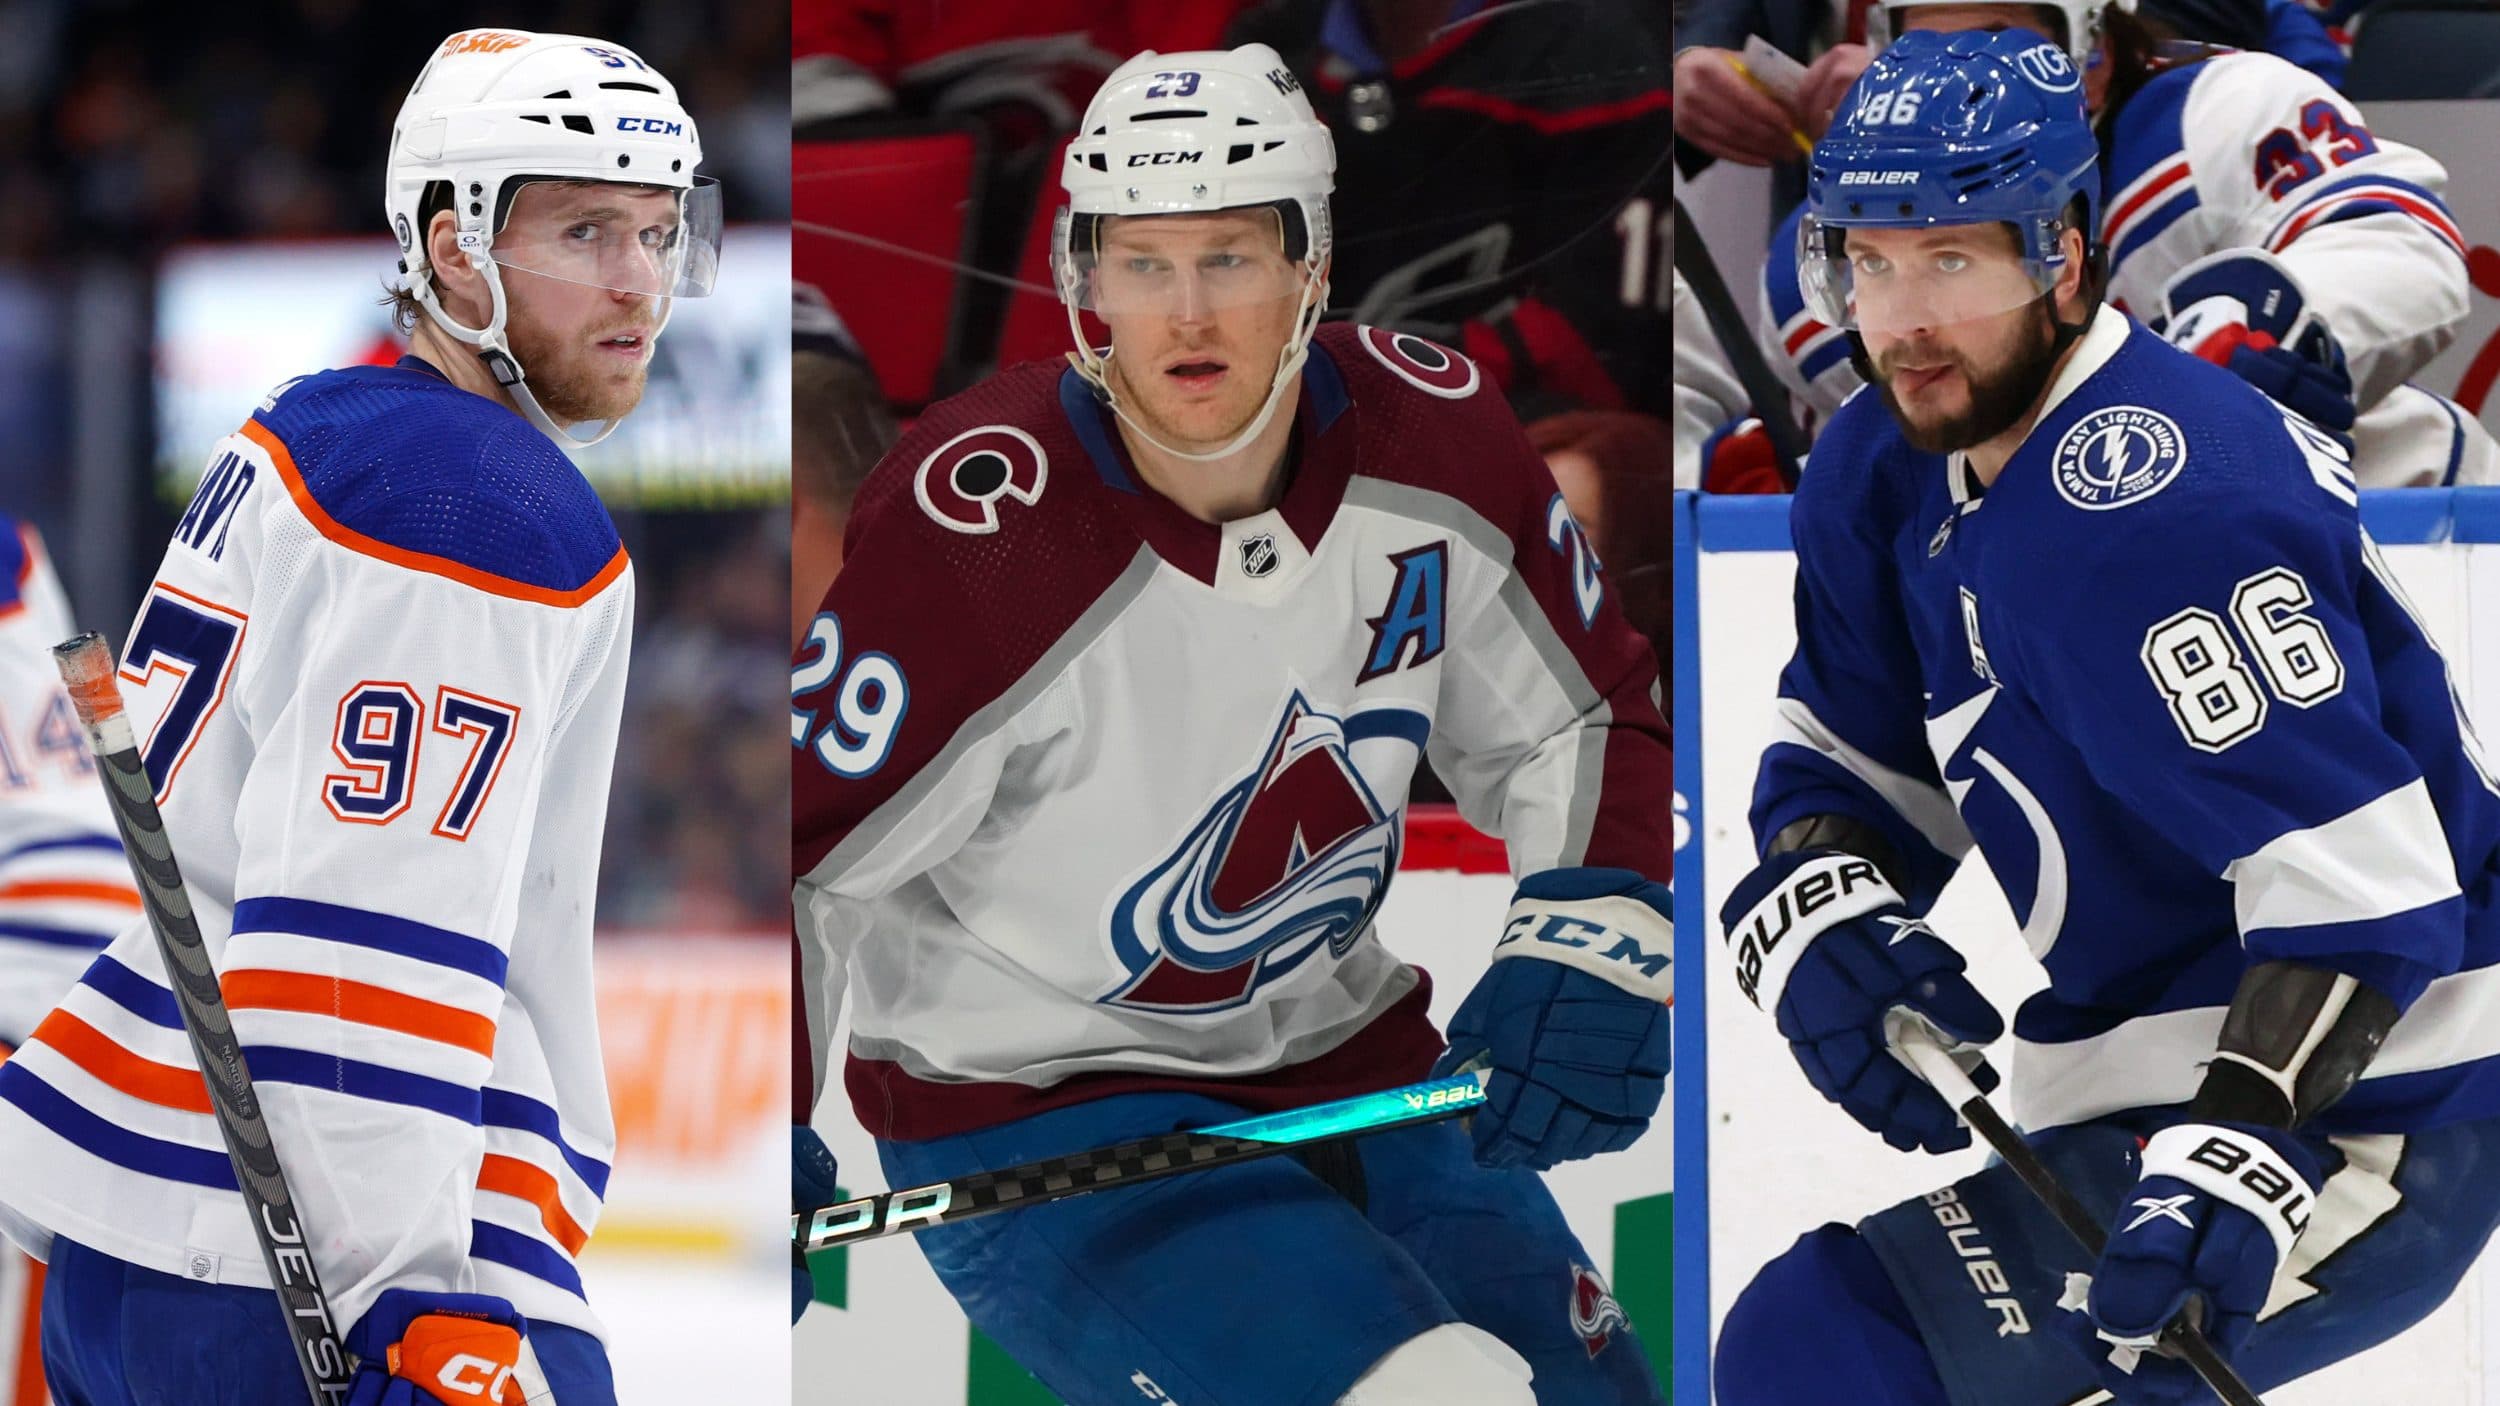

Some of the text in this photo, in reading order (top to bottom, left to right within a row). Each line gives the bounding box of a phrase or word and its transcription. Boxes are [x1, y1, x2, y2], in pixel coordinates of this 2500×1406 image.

[1145, 71, 1202, 100] 29
[1863, 91, 1922, 126] 86
[616, 117, 682, 136] CCM
[1127, 151, 1203, 168] CCM
[2061, 412, 2176, 501] TAMPA BAY LIGHTNING
[1248, 543, 1271, 572] NHL
[1548, 490, 1604, 632] 2
[1355, 539, 1449, 688] A
[791, 610, 910, 780] 29
[2139, 565, 2345, 754] 86
[320, 679, 522, 842] 97
[1496, 913, 1673, 979] CCM
[791, 1182, 952, 1250] PR
[2187, 1136, 2312, 1250] BAU
